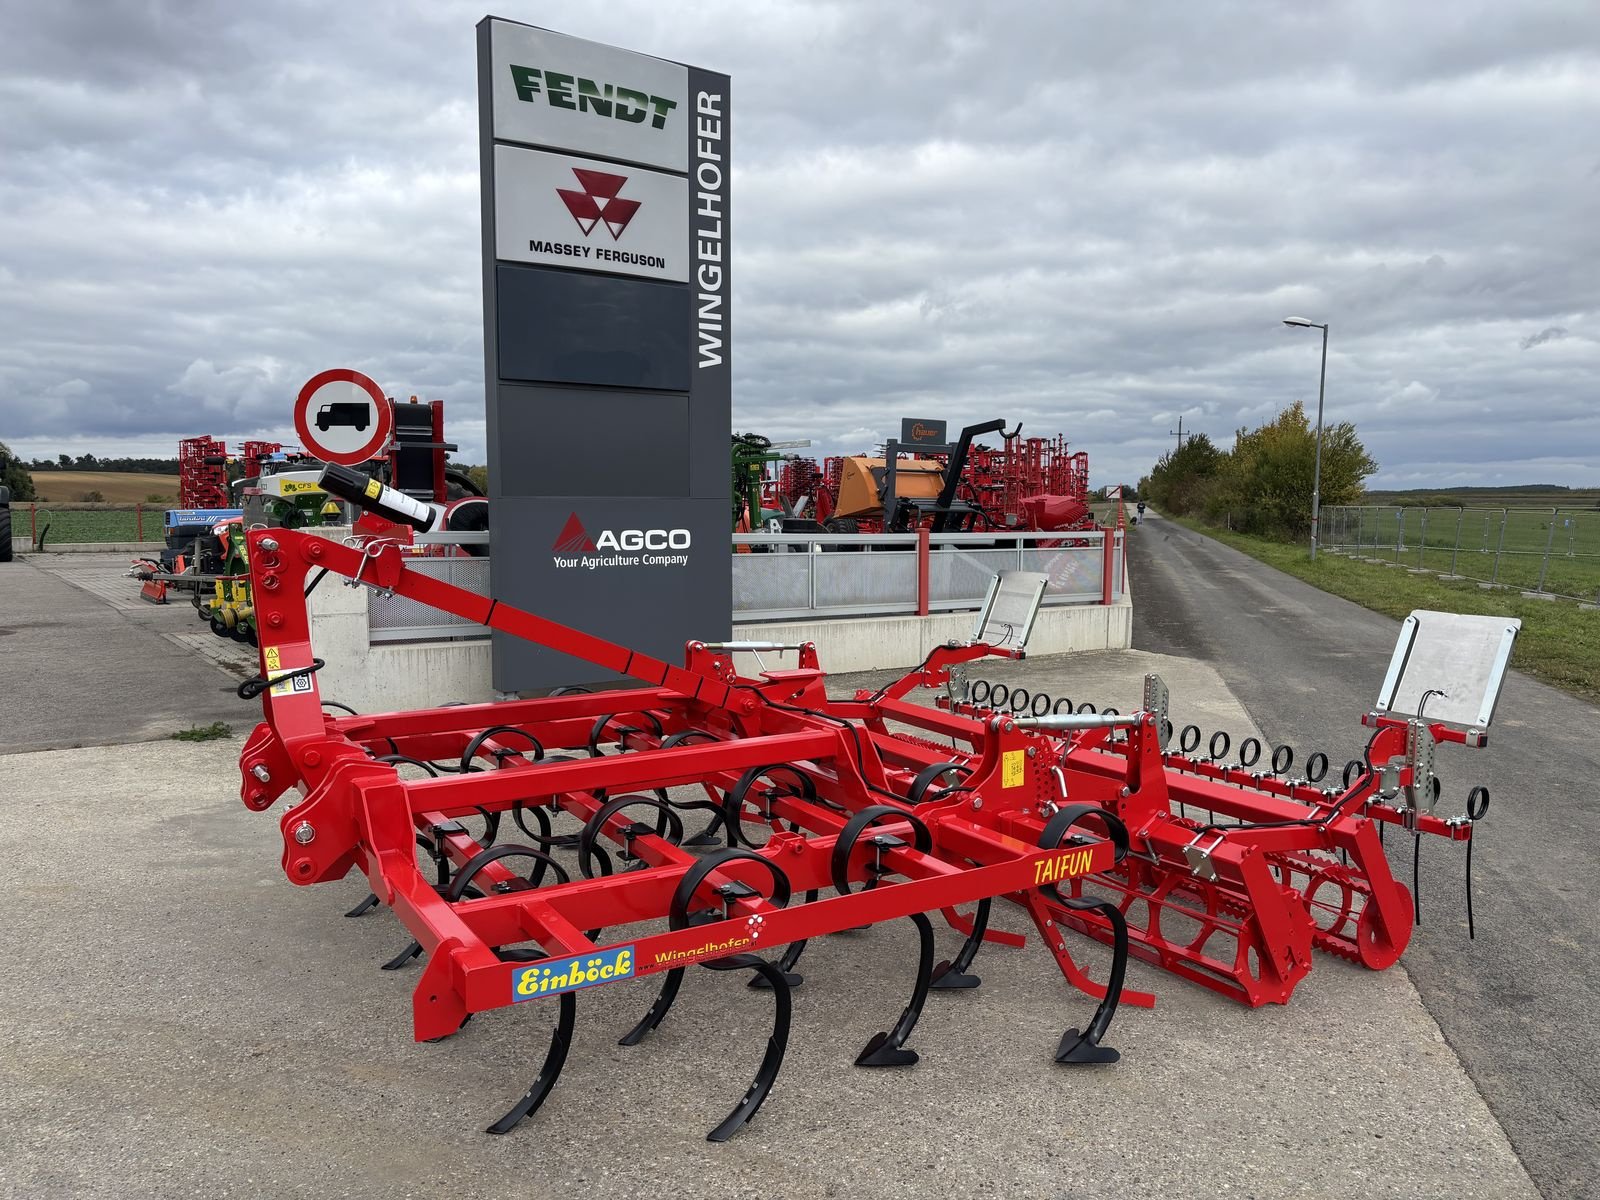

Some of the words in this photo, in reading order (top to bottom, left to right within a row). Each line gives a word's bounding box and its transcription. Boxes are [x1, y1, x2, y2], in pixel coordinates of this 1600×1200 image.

[509, 63, 678, 130] FENDT
[696, 90, 722, 369] WINGELHOFER
[529, 239, 591, 258] MASSEY
[595, 247, 666, 269] FERGUSON
[596, 529, 692, 551] AGCO
[553, 555, 579, 569] Your
[580, 554, 640, 570] Agriculture
[641, 553, 689, 568] Company
[1034, 848, 1094, 885] TAIFUN
[516, 949, 632, 997] Einböck
